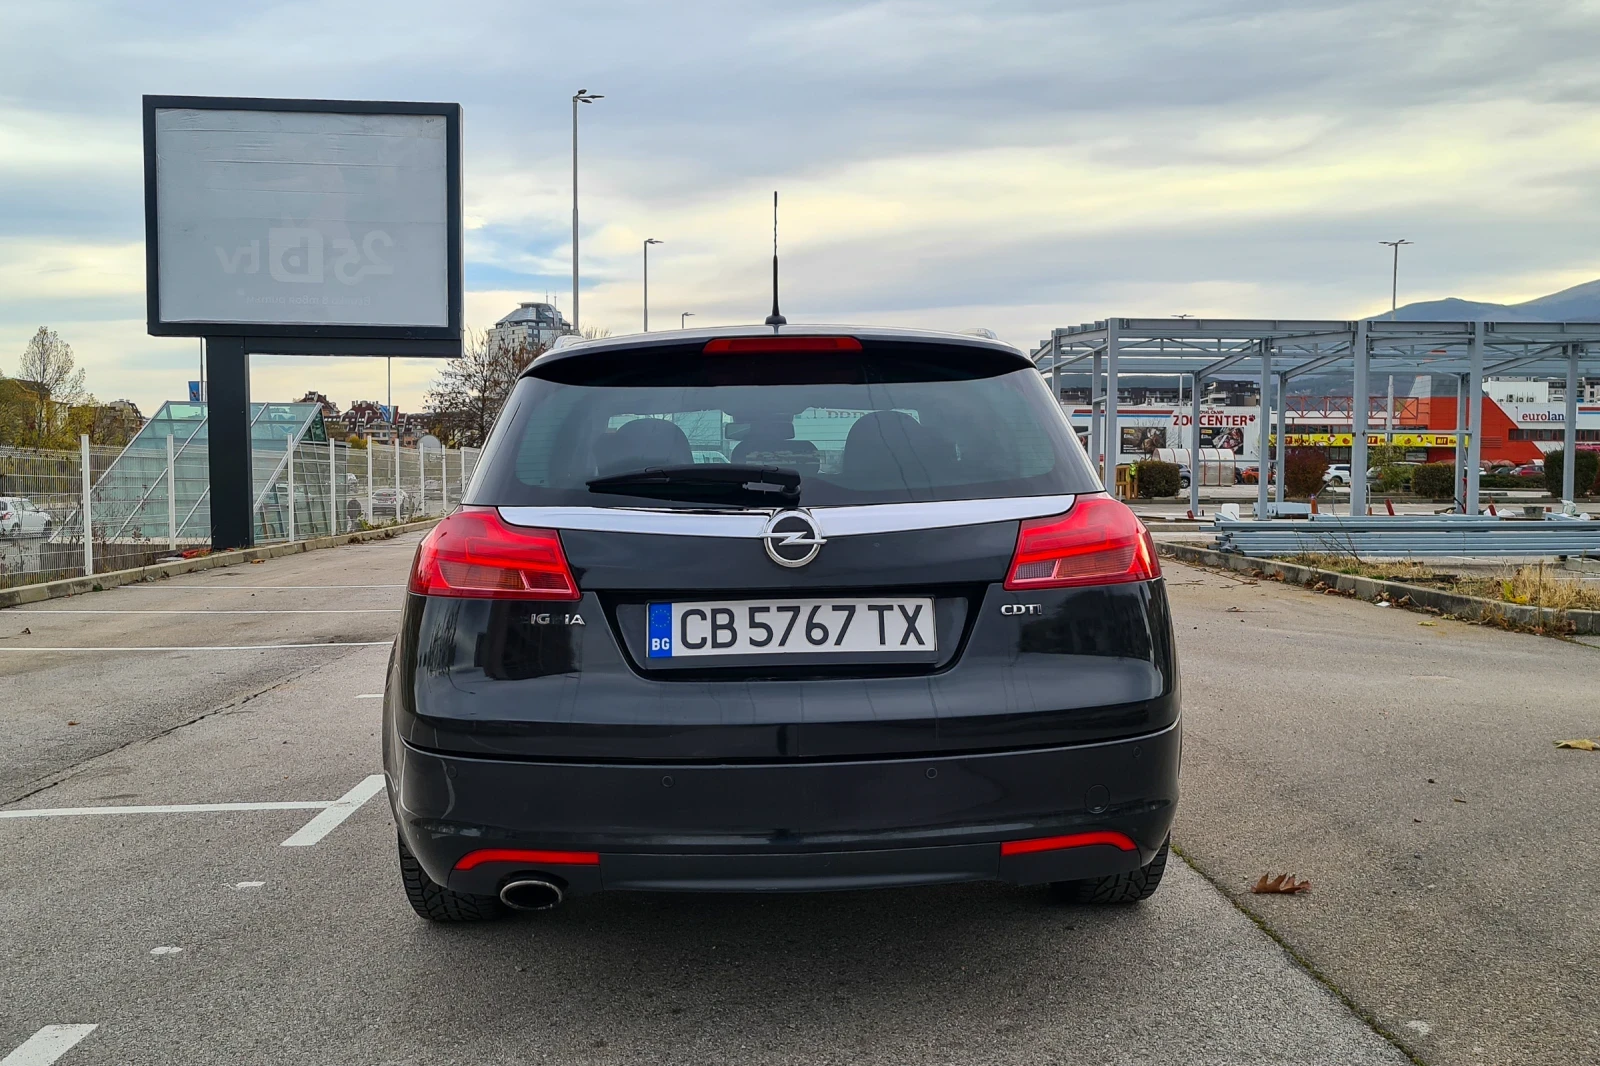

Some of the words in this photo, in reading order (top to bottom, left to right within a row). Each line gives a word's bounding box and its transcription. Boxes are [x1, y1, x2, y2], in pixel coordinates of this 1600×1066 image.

[1522, 410, 1565, 421] eurolan
[1000, 603, 1042, 615] CDTI
[680, 608, 738, 650] CB
[748, 605, 856, 648] 5767
[867, 604, 927, 646] TX
[651, 638, 670, 651] BG
